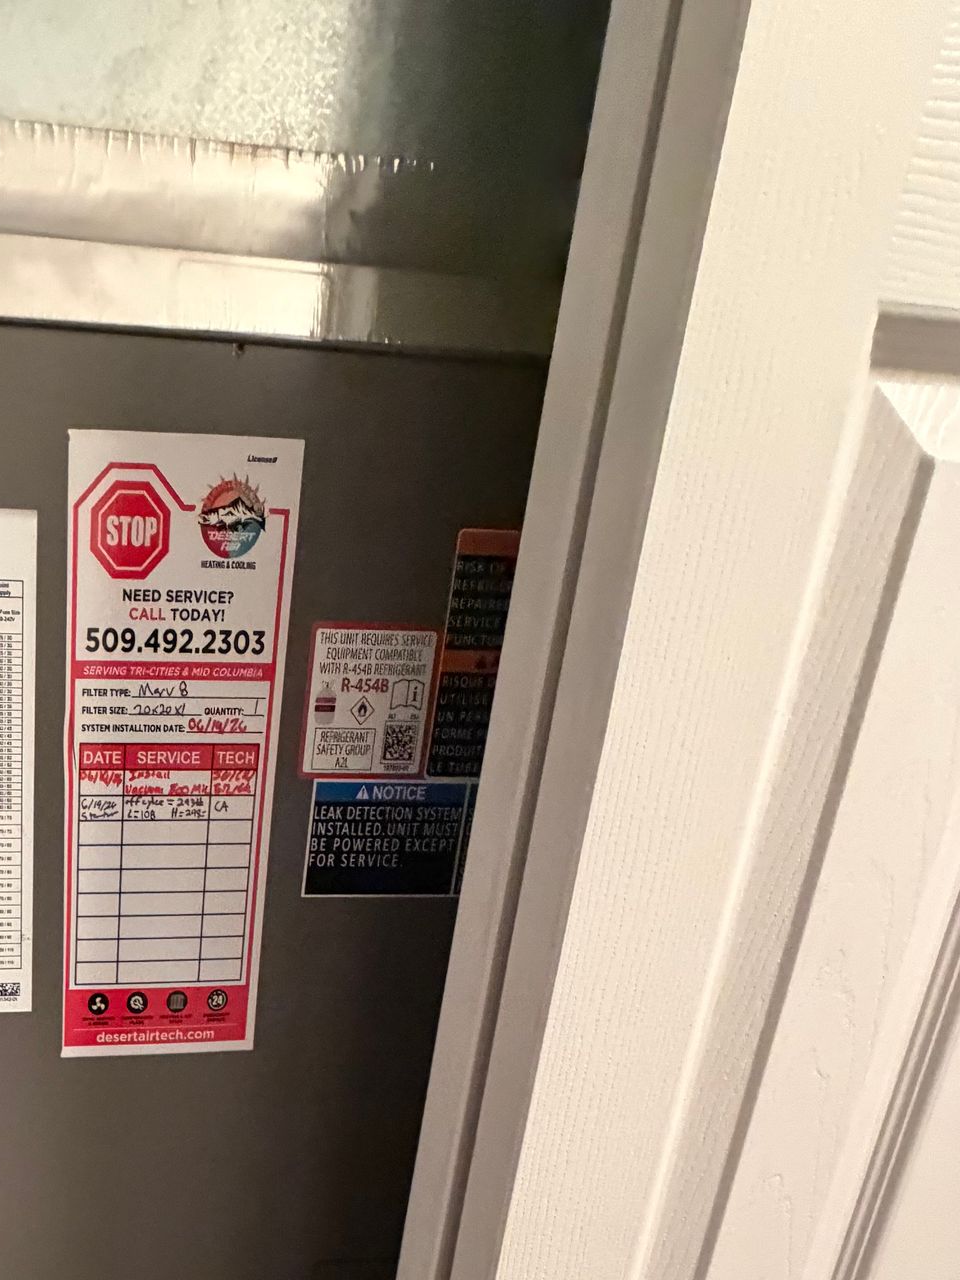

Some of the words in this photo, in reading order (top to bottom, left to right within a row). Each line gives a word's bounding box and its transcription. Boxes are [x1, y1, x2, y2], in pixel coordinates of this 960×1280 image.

[106, 515, 158, 547] STOP
[207, 530, 256, 541] DESERT
[201, 560, 225, 569] HEATING
[231, 561, 256, 571] COOLING
[122, 588, 162, 602] NEED
[166, 590, 234, 604] SERVICE?
[129, 607, 166, 621] CALL
[171, 608, 225, 622] TODAY!
[85, 627, 266, 656] 509.492.2303
[320, 631, 339, 645] THIS
[341, 632, 359, 645] UNIT
[361, 632, 400, 646] REQUIRES
[401, 633, 434, 647] SERVICE
[326, 647, 373, 661] EQUIPMENT
[374, 648, 423, 662] COMPATIBLE
[83, 665, 127, 676] SERVING
[130, 666, 180, 677] TRI-CITIES
[181, 667, 189, 677] &
[191, 667, 211, 677] MID
[213, 667, 263, 678] COLUMBIA
[320, 662, 340, 675] WITH
[342, 663, 372, 675] R-454B
[373, 663, 427, 676] REFRIGERANT
[341, 677, 390, 693] R-454B
[81, 688, 108, 697] FILTER
[110, 688, 131, 697] TYPE:
[81, 706, 108, 715] FILTER
[109, 706, 128, 715] SIZE:
[204, 707, 244, 716] QUANTITY:
[81, 724, 111, 732] SYSTEM
[112, 724, 162, 733] INSTALLTION
[163, 724, 186, 733] DATE:
[320, 731, 370, 743] REFRIGERANT
[316, 744, 343, 756] SAFETY
[345, 744, 371, 756] GROUP
[83, 751, 122, 764] DATE
[137, 751, 201, 764] SERVICE
[217, 751, 255, 764] TECH
[372, 786, 427, 800] NOTICE
[314, 806, 342, 820] LEAK
[346, 806, 413, 821] DETECTION
[415, 807, 462, 821] SYSTEM
[312, 822, 385, 836] INSTALLED.
[387, 823, 418, 836] UNIT
[423, 823, 458, 836] MUST
[310, 838, 326, 851] BE
[333, 838, 400, 851] POWERED
[405, 838, 455, 852] EXCEPT
[309, 854, 335, 867] FOR
[340, 854, 403, 868] SERVICE.
[212, 995, 223, 1005] 24
[96, 1028, 215, 1043] desertairtech.com
